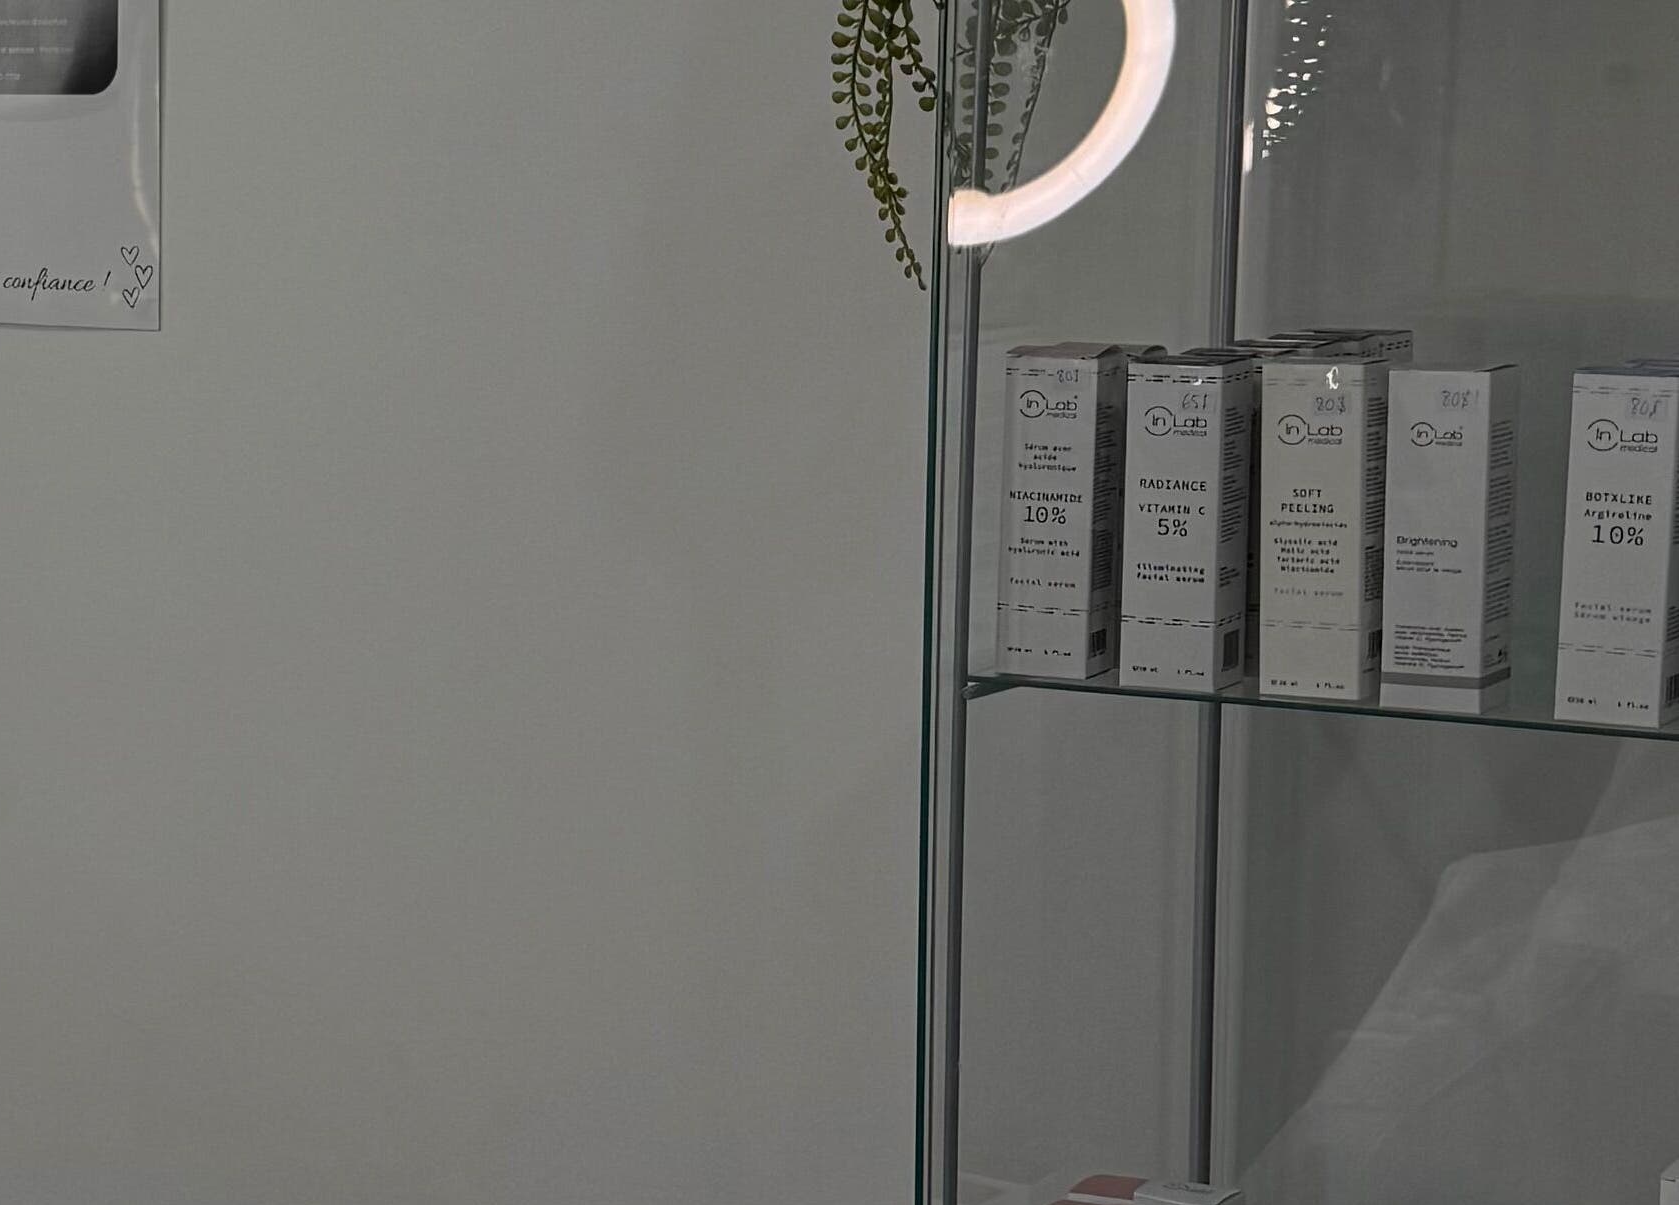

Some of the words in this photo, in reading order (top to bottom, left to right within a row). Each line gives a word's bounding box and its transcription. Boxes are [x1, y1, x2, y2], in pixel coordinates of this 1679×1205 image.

[3, 267, 96, 301] confiance
[1046, 399, 1077, 410] Lab
[1152, 413, 1165, 426] In
[1173, 414, 1207, 428] Lab
[1285, 423, 1299, 435] In
[1307, 423, 1343, 436] Lab
[1434, 430, 1463, 440] Lab
[1596, 428, 1611, 441] In
[1620, 429, 1658, 443] Lab
[1139, 479, 1207, 492] RADIANCE
[1009, 490, 1083, 503] NIACINAMIDE
[1292, 488, 1322, 498] SOFT
[1585, 491, 1652, 505] BOTXLIKE
[1023, 505, 1066, 524] 10%
[1138, 503, 1191, 515] VITAMIN
[1198, 506, 1205, 515] C
[1281, 503, 1334, 513] PEELING
[1157, 518, 1188, 537] 5%
[1396, 535, 1458, 548] Brightening
[1592, 524, 1644, 546] 10%
